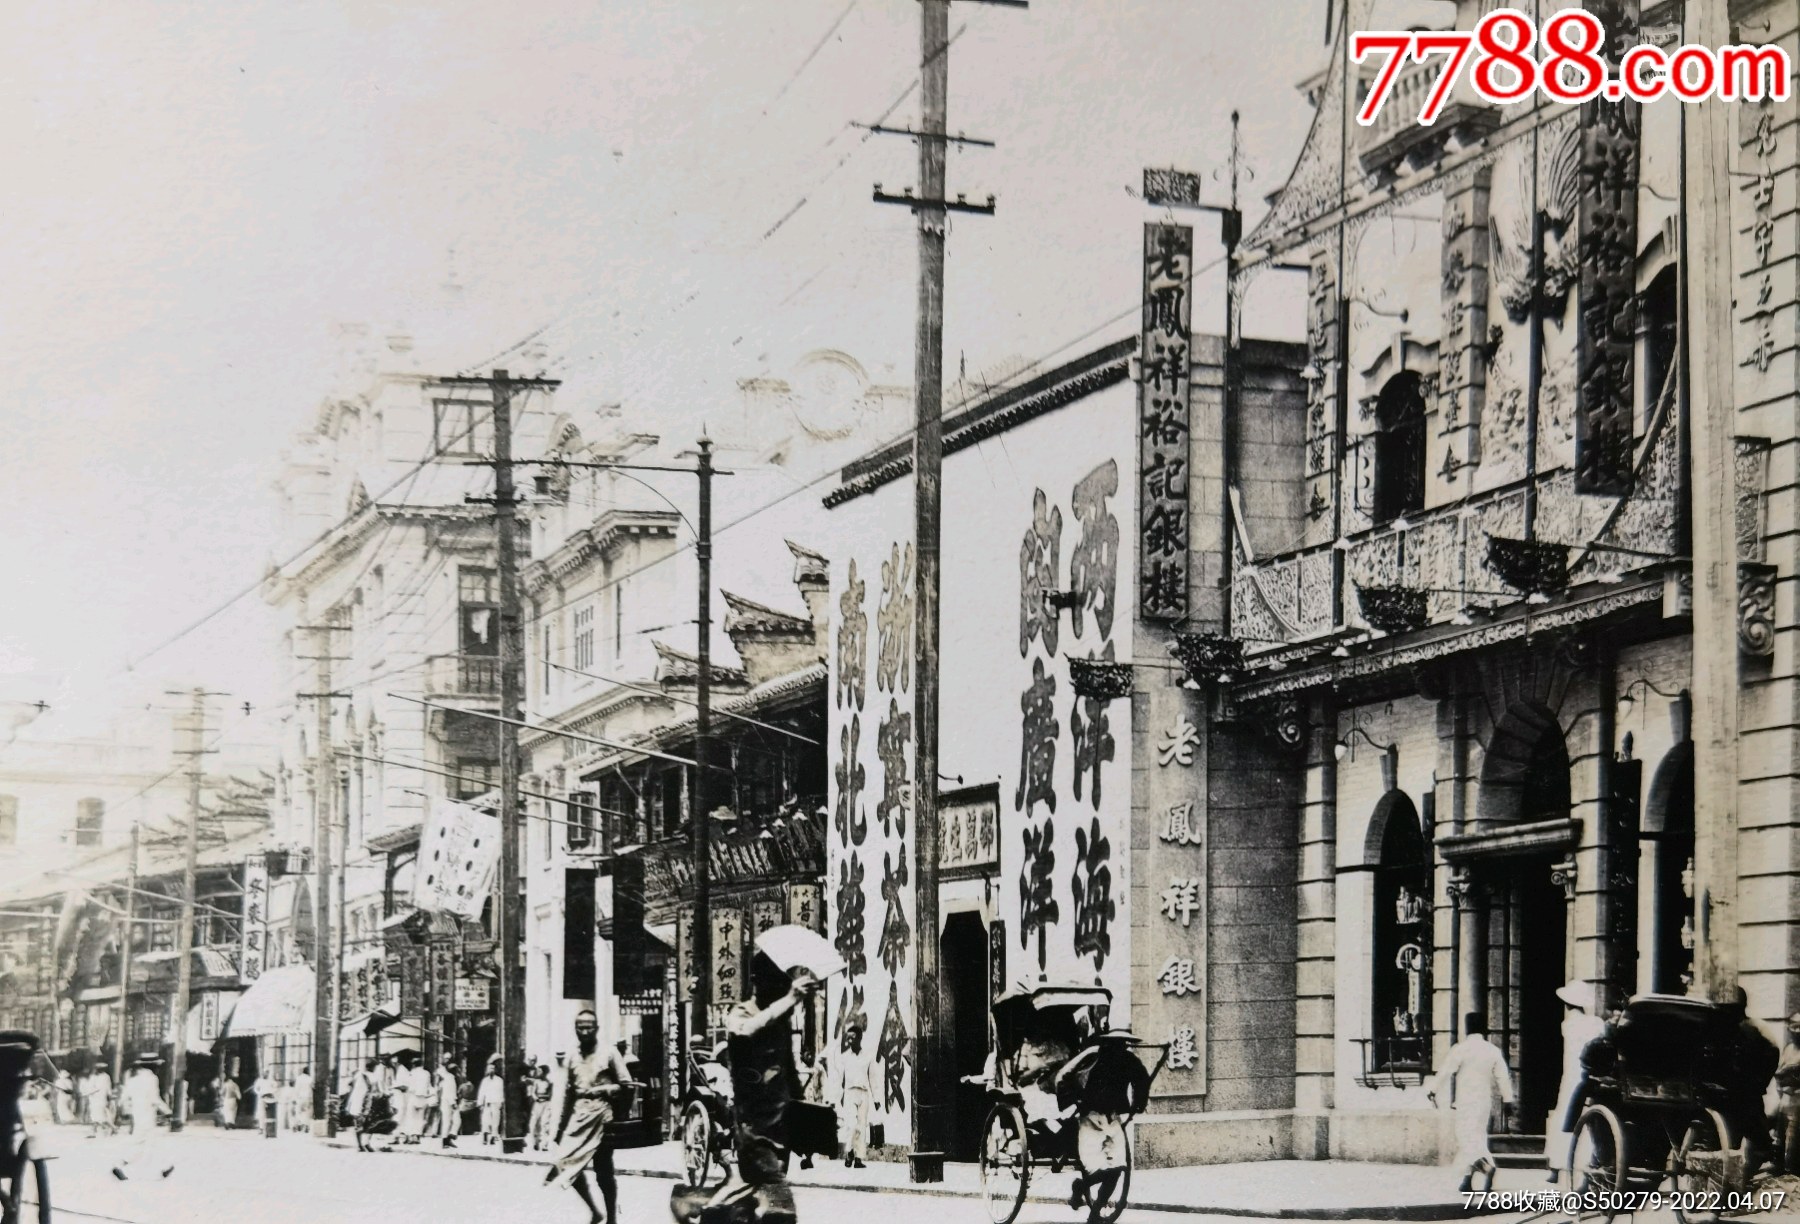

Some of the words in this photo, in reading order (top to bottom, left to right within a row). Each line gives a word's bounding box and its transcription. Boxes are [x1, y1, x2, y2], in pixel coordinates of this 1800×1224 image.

[1146, 229, 1189, 614] 老鳳祥裕記銀樓
[1158, 713, 1200, 1071] 老鳳祥銀樓
